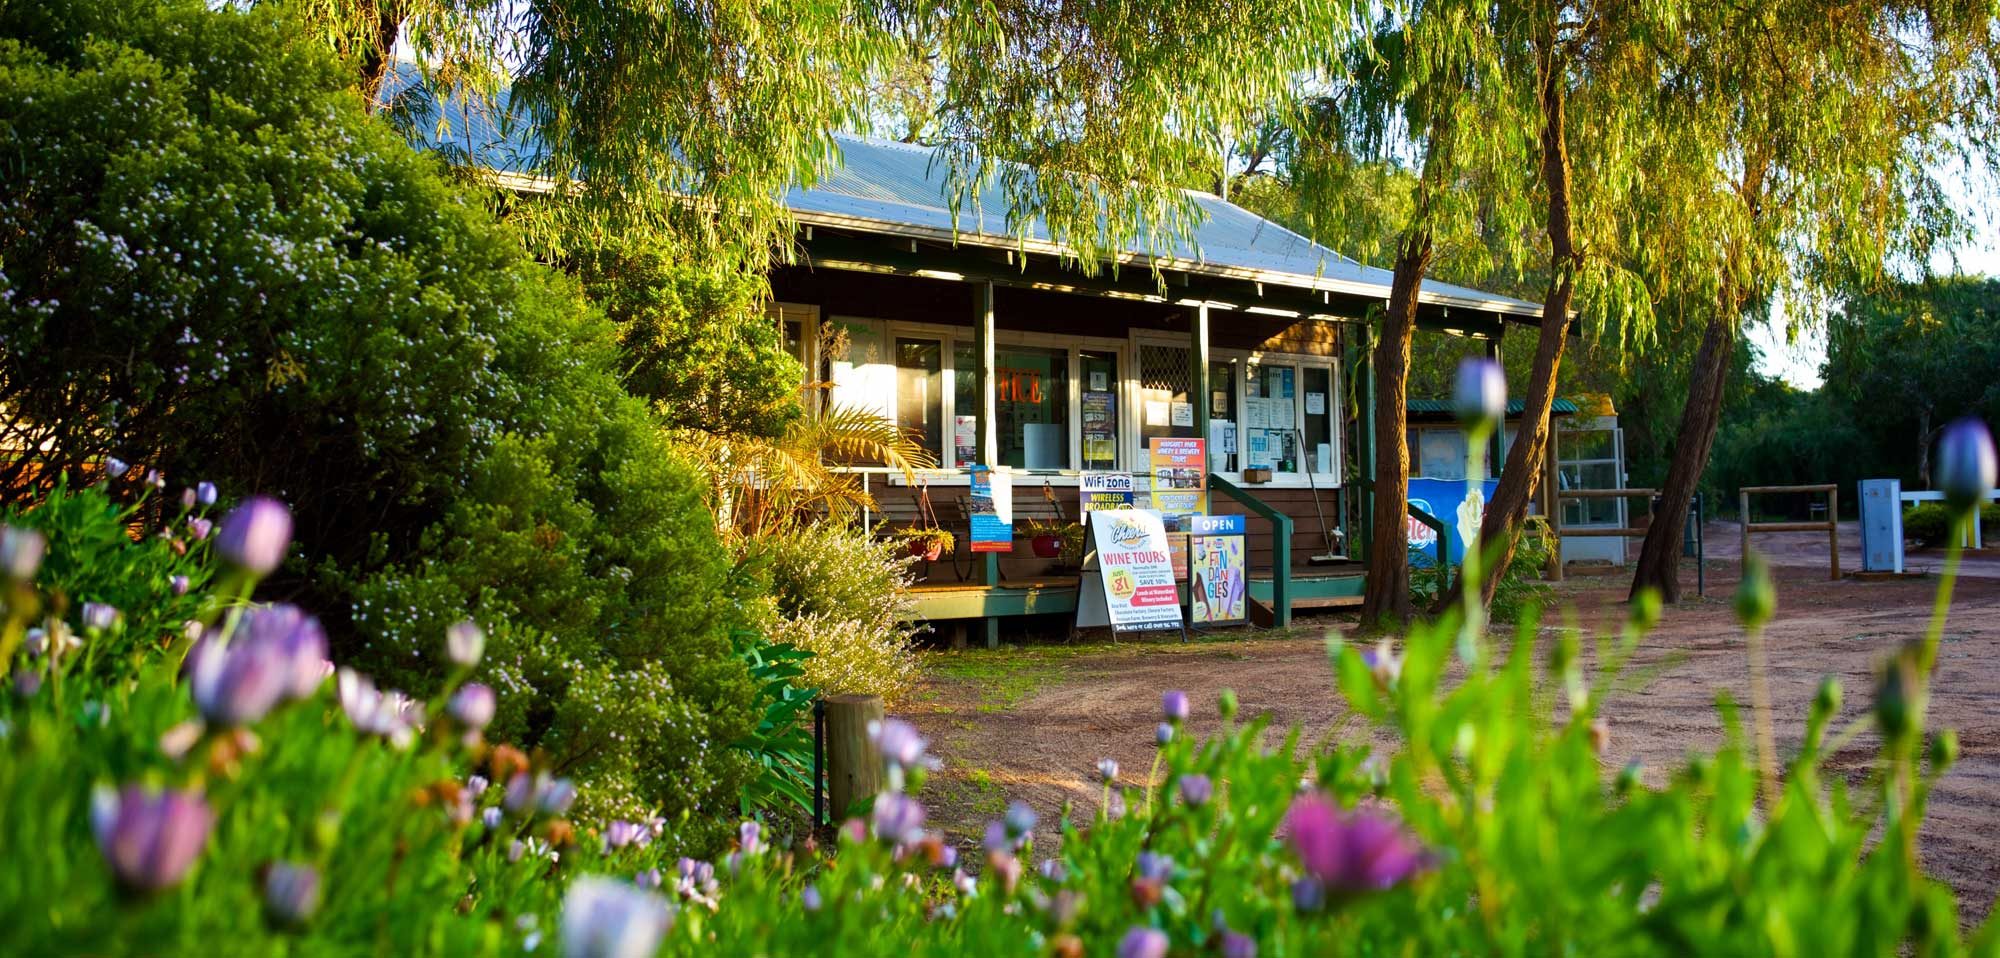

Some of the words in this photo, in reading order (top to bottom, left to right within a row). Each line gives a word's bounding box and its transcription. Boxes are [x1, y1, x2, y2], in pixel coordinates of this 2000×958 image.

[995, 368, 1041, 404] FICE
[1084, 475, 1105, 488] WiFi
[1106, 477, 1130, 488] zone
[1090, 493, 1125, 502] WIRELESS
[1202, 519, 1234, 531] OPEN
[1103, 552, 1132, 565] WINE
[1132, 550, 1166, 564] TOURS
[1209, 550, 1227, 569] FAN
[1208, 567, 1228, 581] DAN
[1207, 581, 1229, 599] GLES
